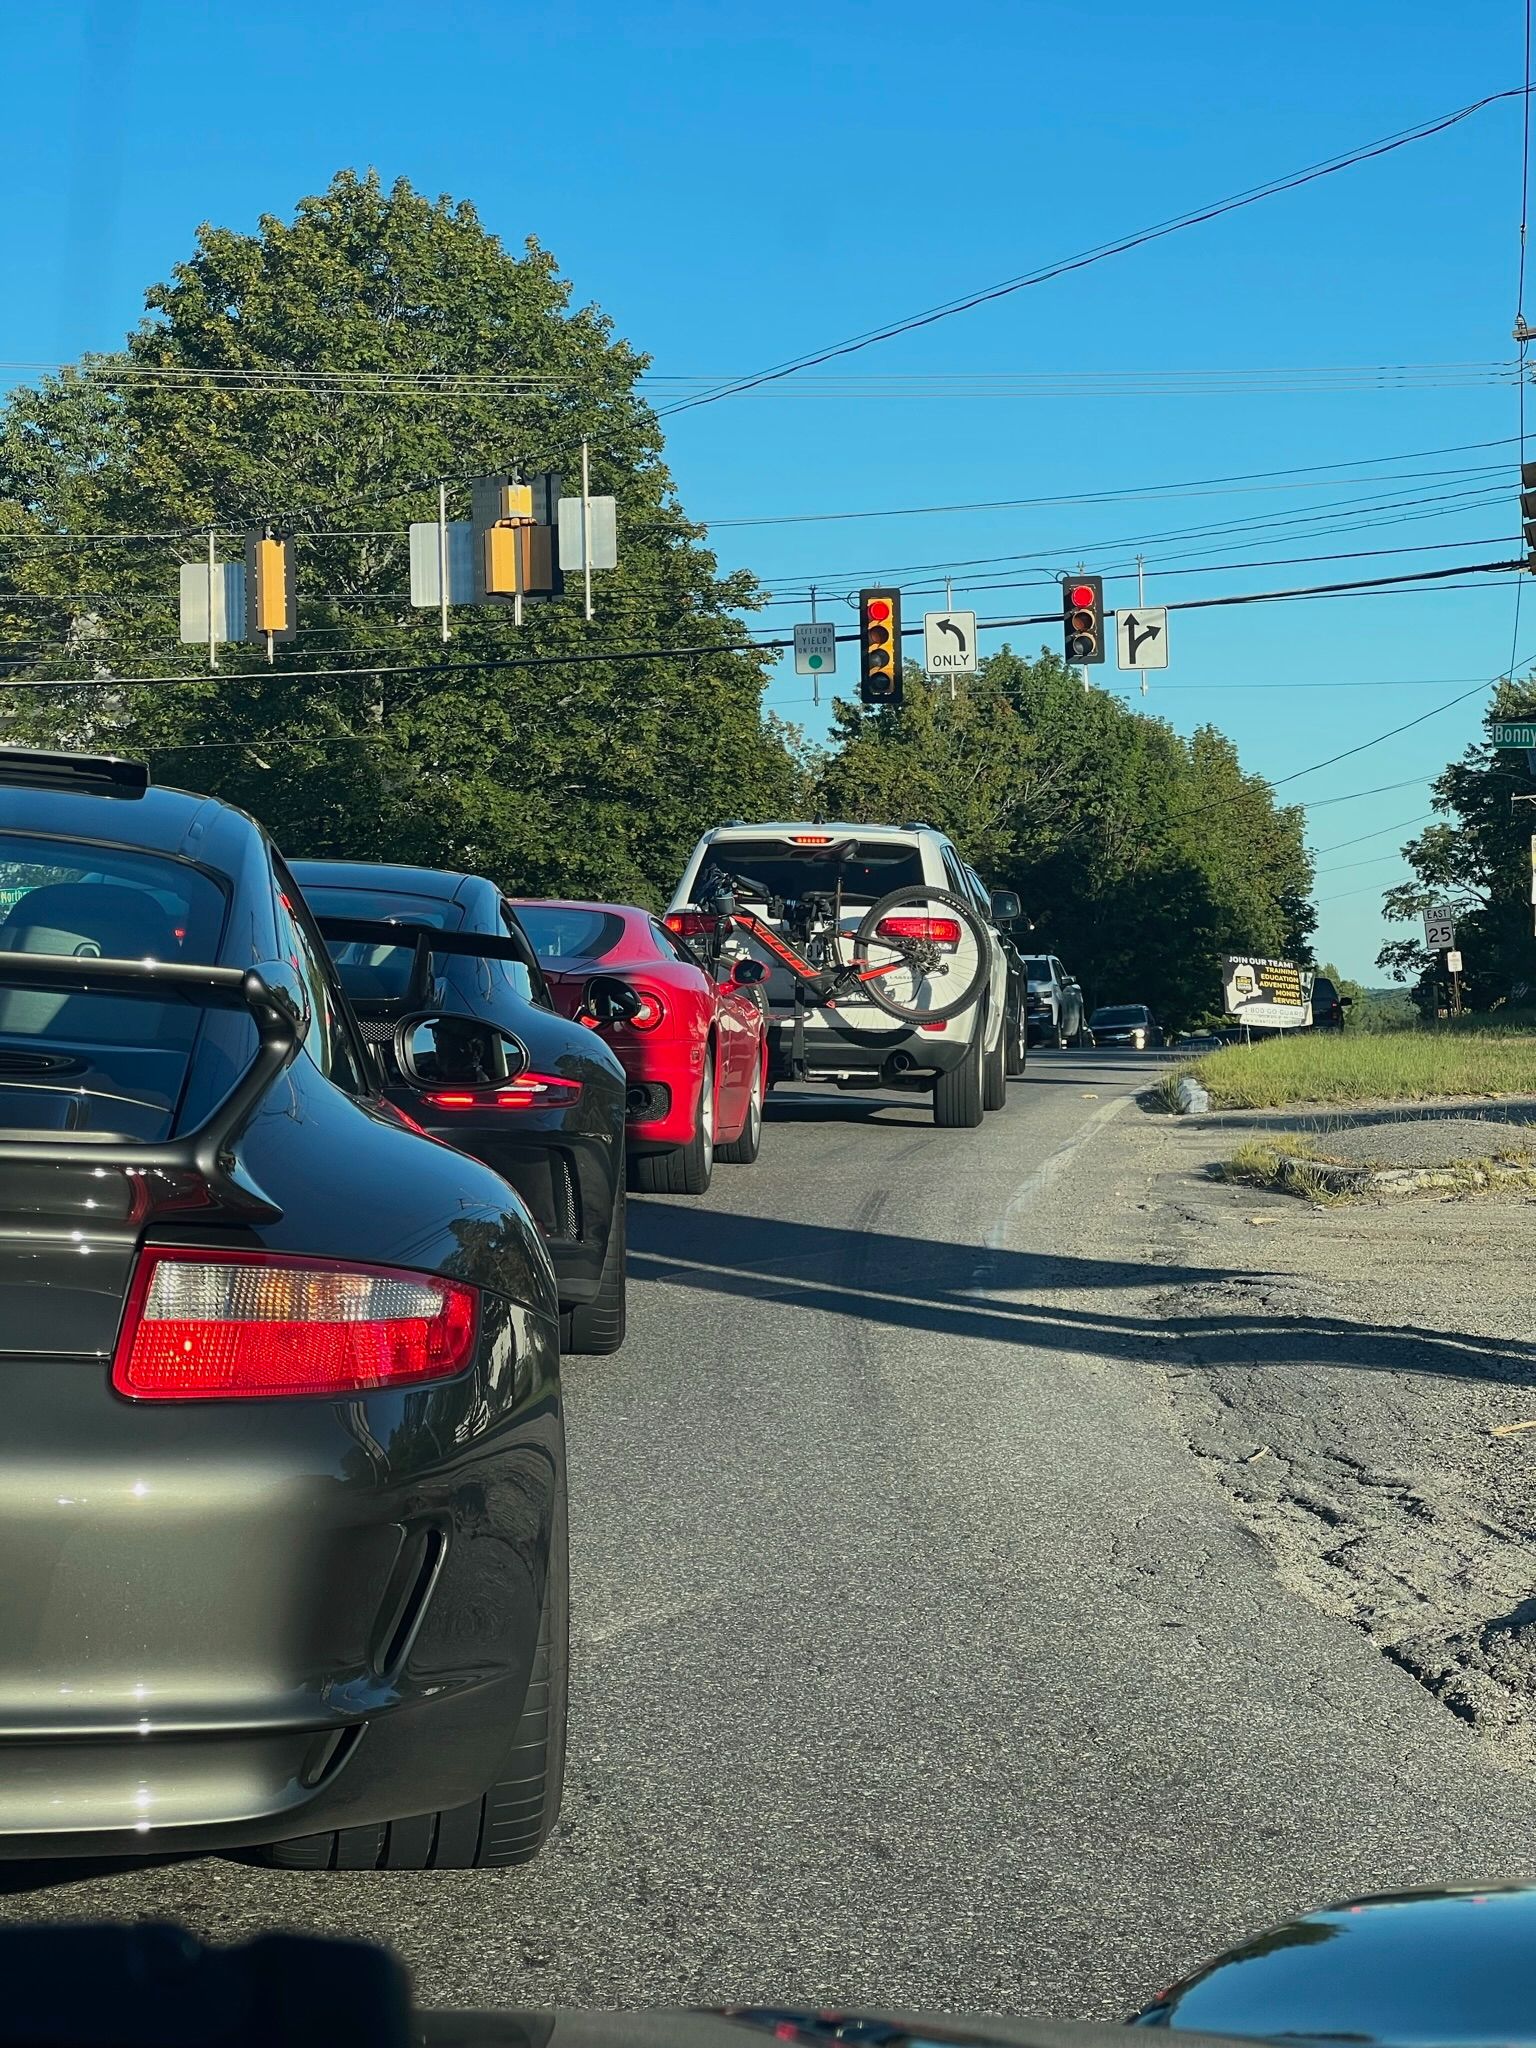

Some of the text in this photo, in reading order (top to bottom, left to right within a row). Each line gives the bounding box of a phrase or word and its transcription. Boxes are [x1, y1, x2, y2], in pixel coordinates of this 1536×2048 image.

[801, 636, 828, 645] YIELD
[933, 655, 970, 667] ONLY
[1426, 910, 1448, 919] EAST
[1428, 927, 1451, 943] 25
[1229, 956, 1293, 968] JOIN OUR TEAM!
[1265, 967, 1298, 975] TRAINING
[1260, 973, 1299, 983] EDUCATION
[1259, 981, 1300, 990] ADVENTURE
[1275, 989, 1300, 998] MONEY
[1272, 997, 1301, 1005] SERVICE
